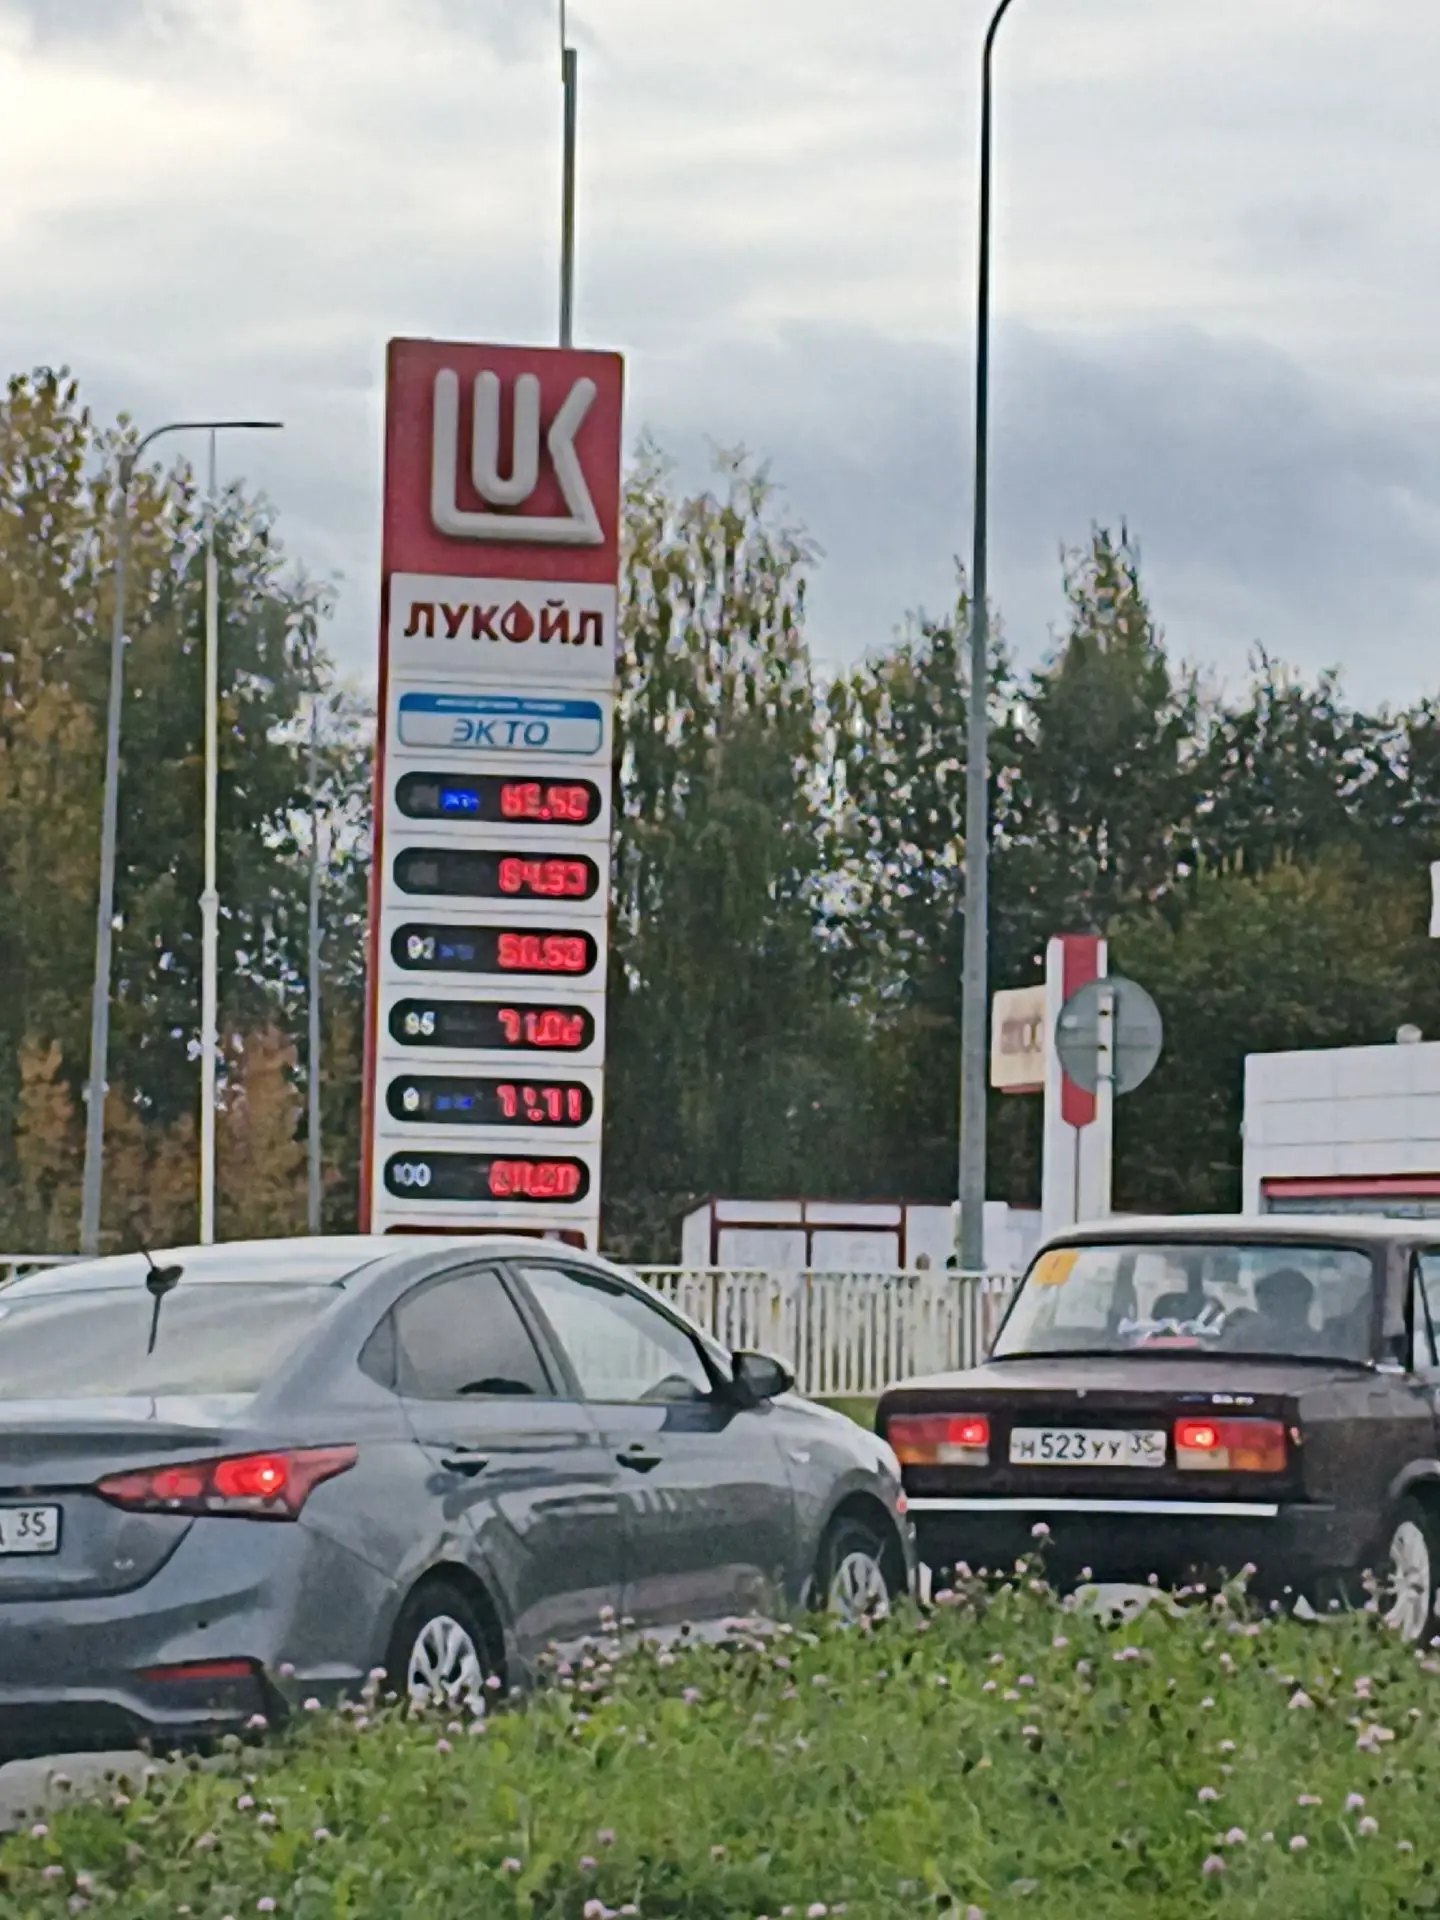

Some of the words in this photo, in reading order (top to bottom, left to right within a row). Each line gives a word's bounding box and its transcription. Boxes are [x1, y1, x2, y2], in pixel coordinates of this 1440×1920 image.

[403, 598, 604, 648] ЛУКОЙЛ
[451, 718, 550, 747] ЭКТО
[404, 1011, 435, 1037] 95
[393, 1162, 431, 1187] 100
[17, 1511, 46, 1537] 35
